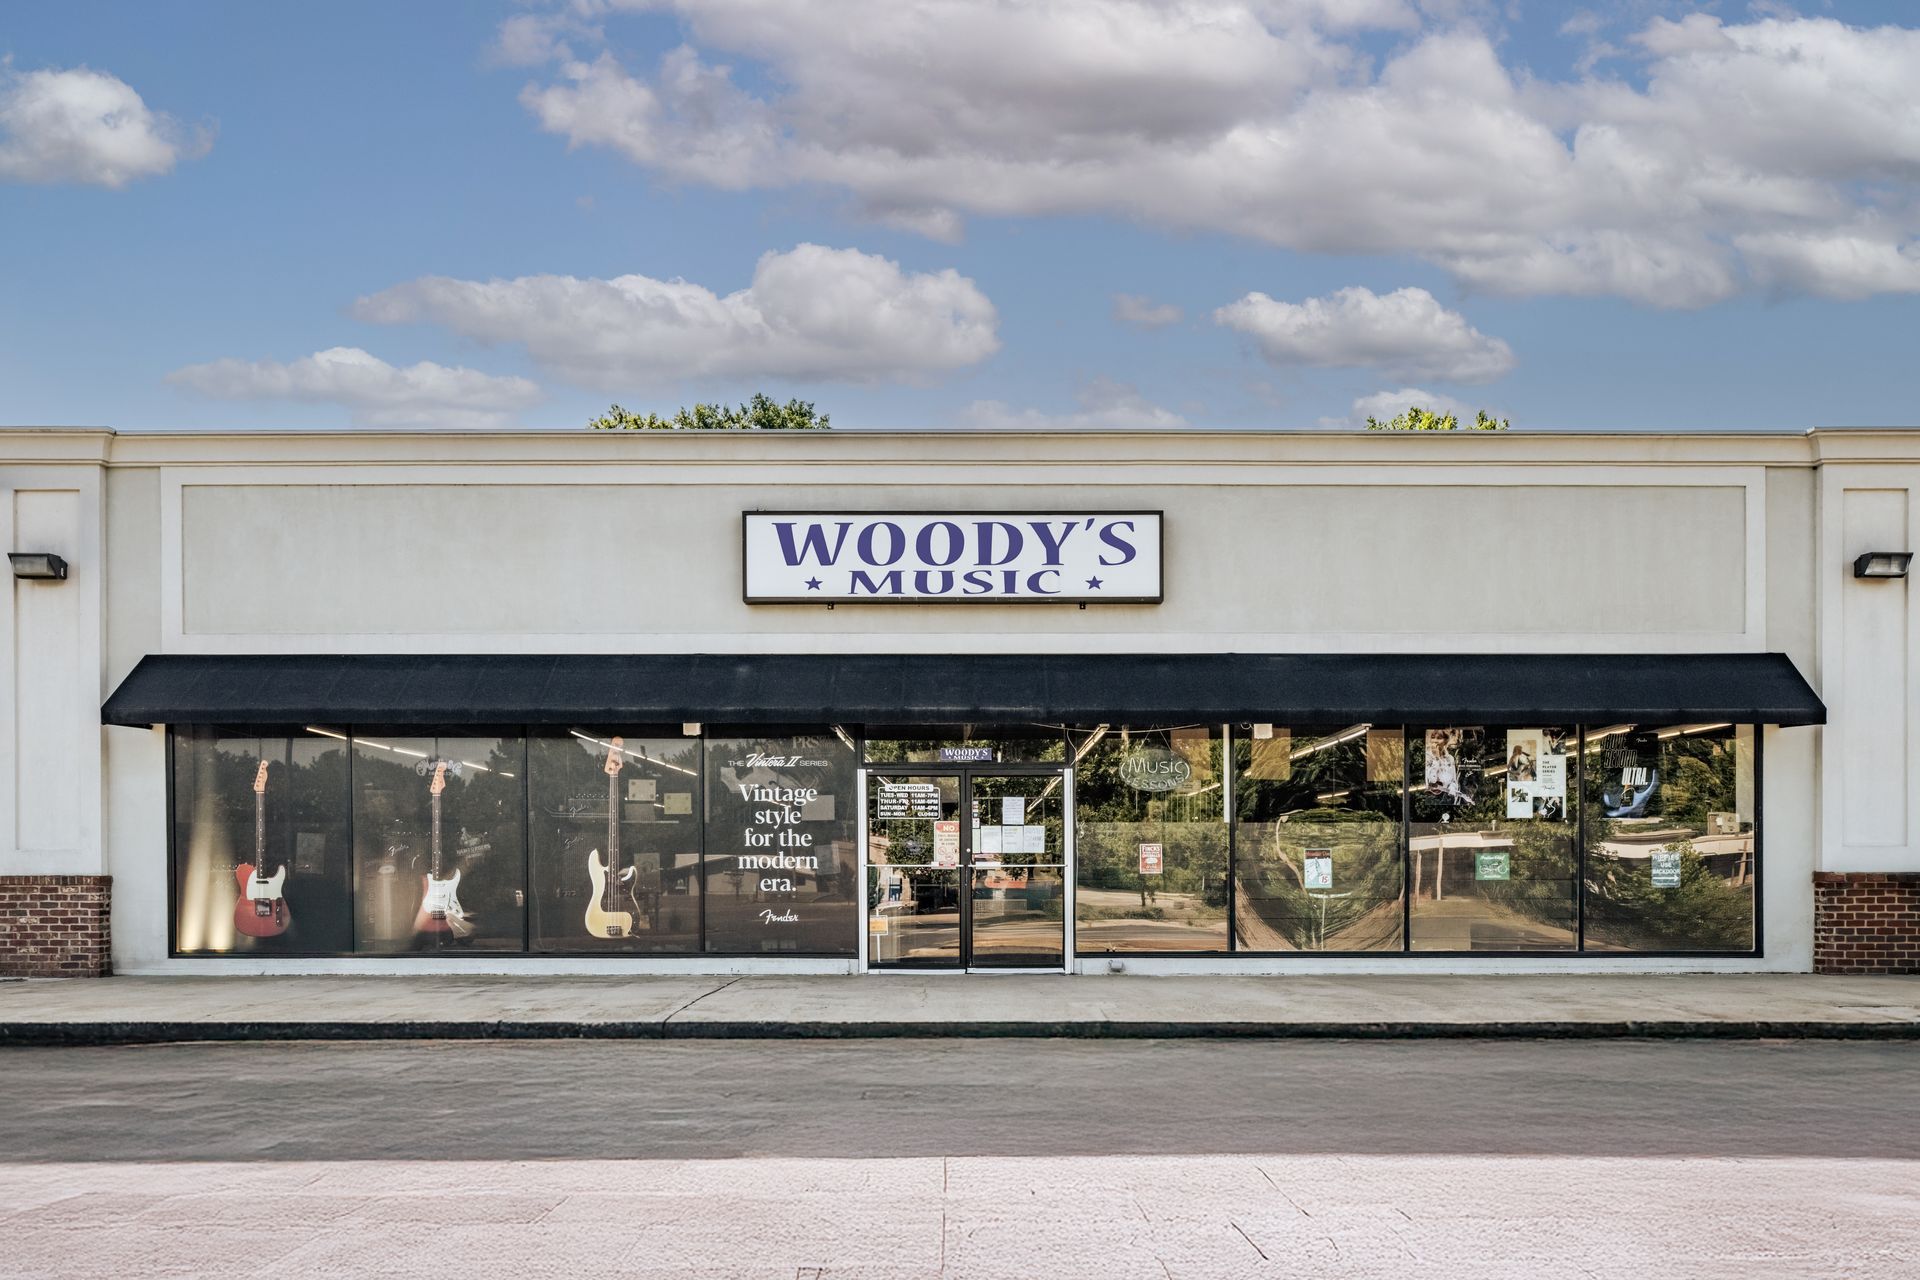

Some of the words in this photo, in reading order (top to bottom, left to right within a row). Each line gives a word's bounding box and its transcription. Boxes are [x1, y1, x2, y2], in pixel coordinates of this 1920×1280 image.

[771, 517, 1137, 567] WOODY'S
[847, 569, 1062, 596] MUSIC
[792, 735, 819, 750] PRS
[746, 752, 786, 768] Vintera
[944, 748, 989, 757] WOODY'S
[1125, 774, 1185, 790] LESSONS
[1621, 767, 1649, 786] ULTRA.
[738, 784, 818, 806] Vintage
[755, 805, 802, 830] style
[943, 824, 955, 832] NO
[744, 827, 774, 847] for
[779, 828, 813, 847] the
[738, 851, 819, 870] modern
[760, 876, 797, 892] era.
[759, 908, 799, 924] Fender
